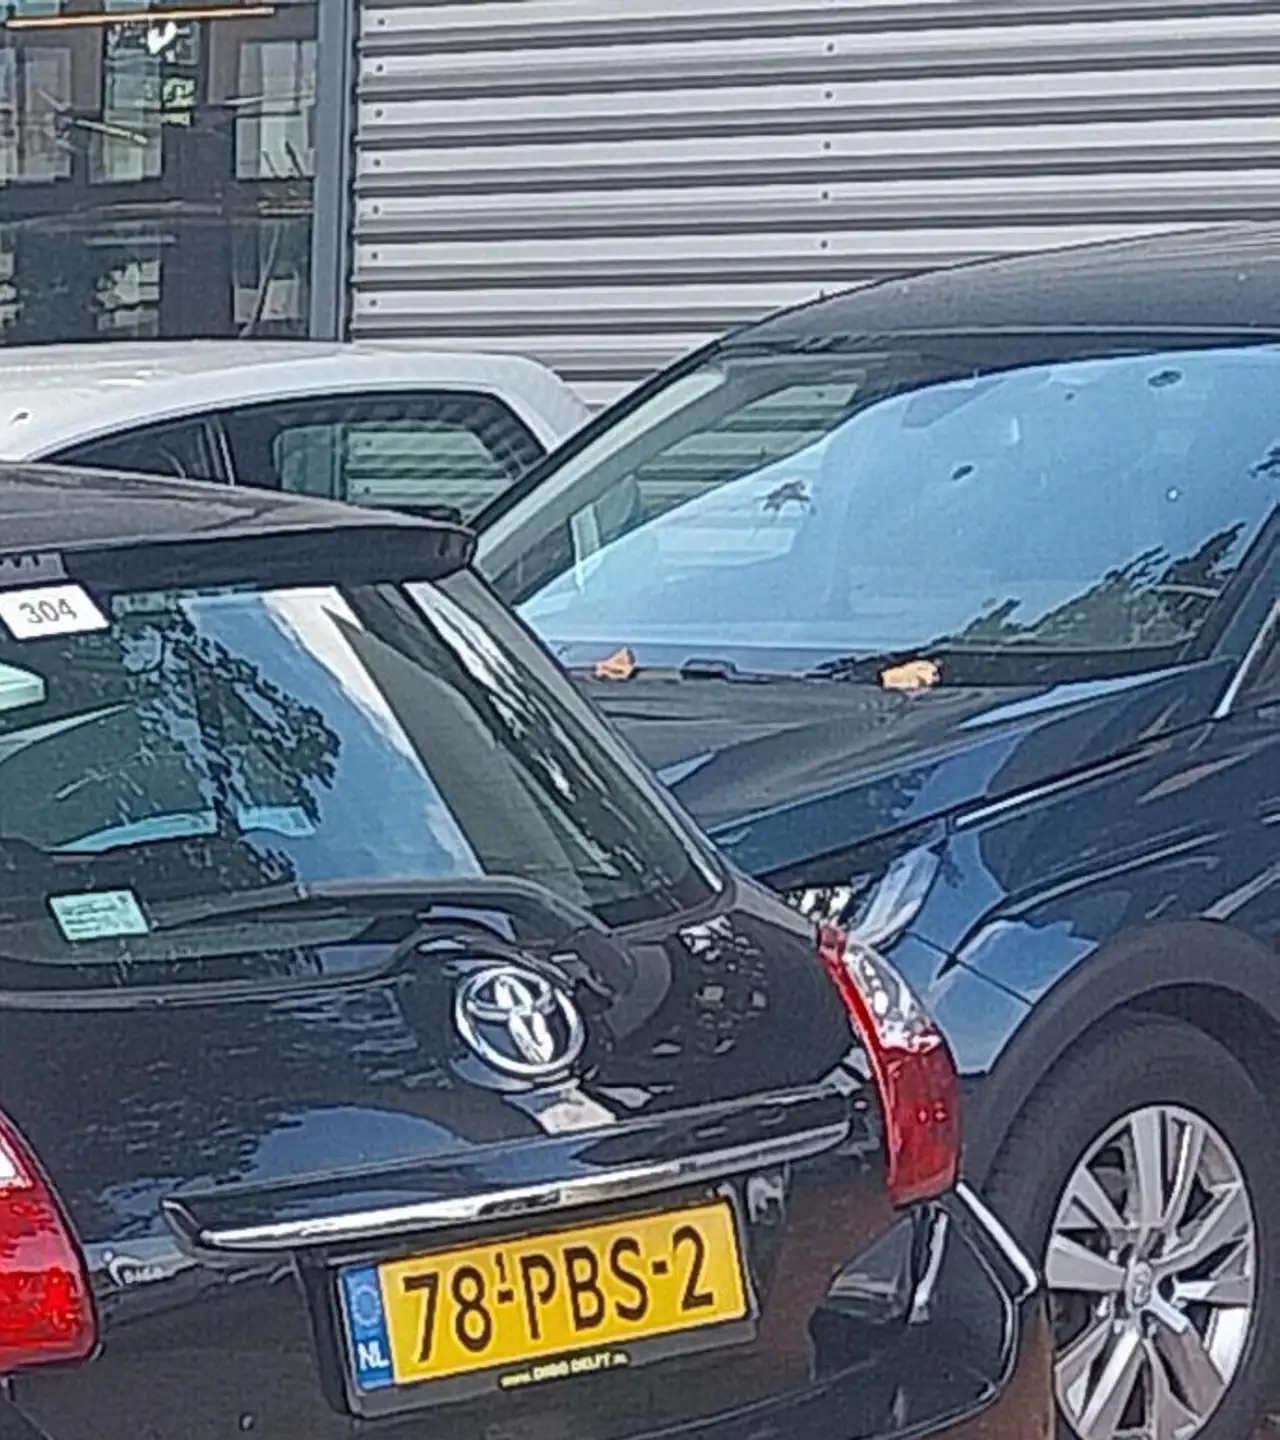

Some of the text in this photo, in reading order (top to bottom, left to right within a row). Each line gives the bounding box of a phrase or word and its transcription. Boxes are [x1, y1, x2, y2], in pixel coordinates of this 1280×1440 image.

[18, 598, 78, 625] 304
[402, 1224, 716, 1364] 78-PBS-2
[357, 1341, 391, 1371] NL
